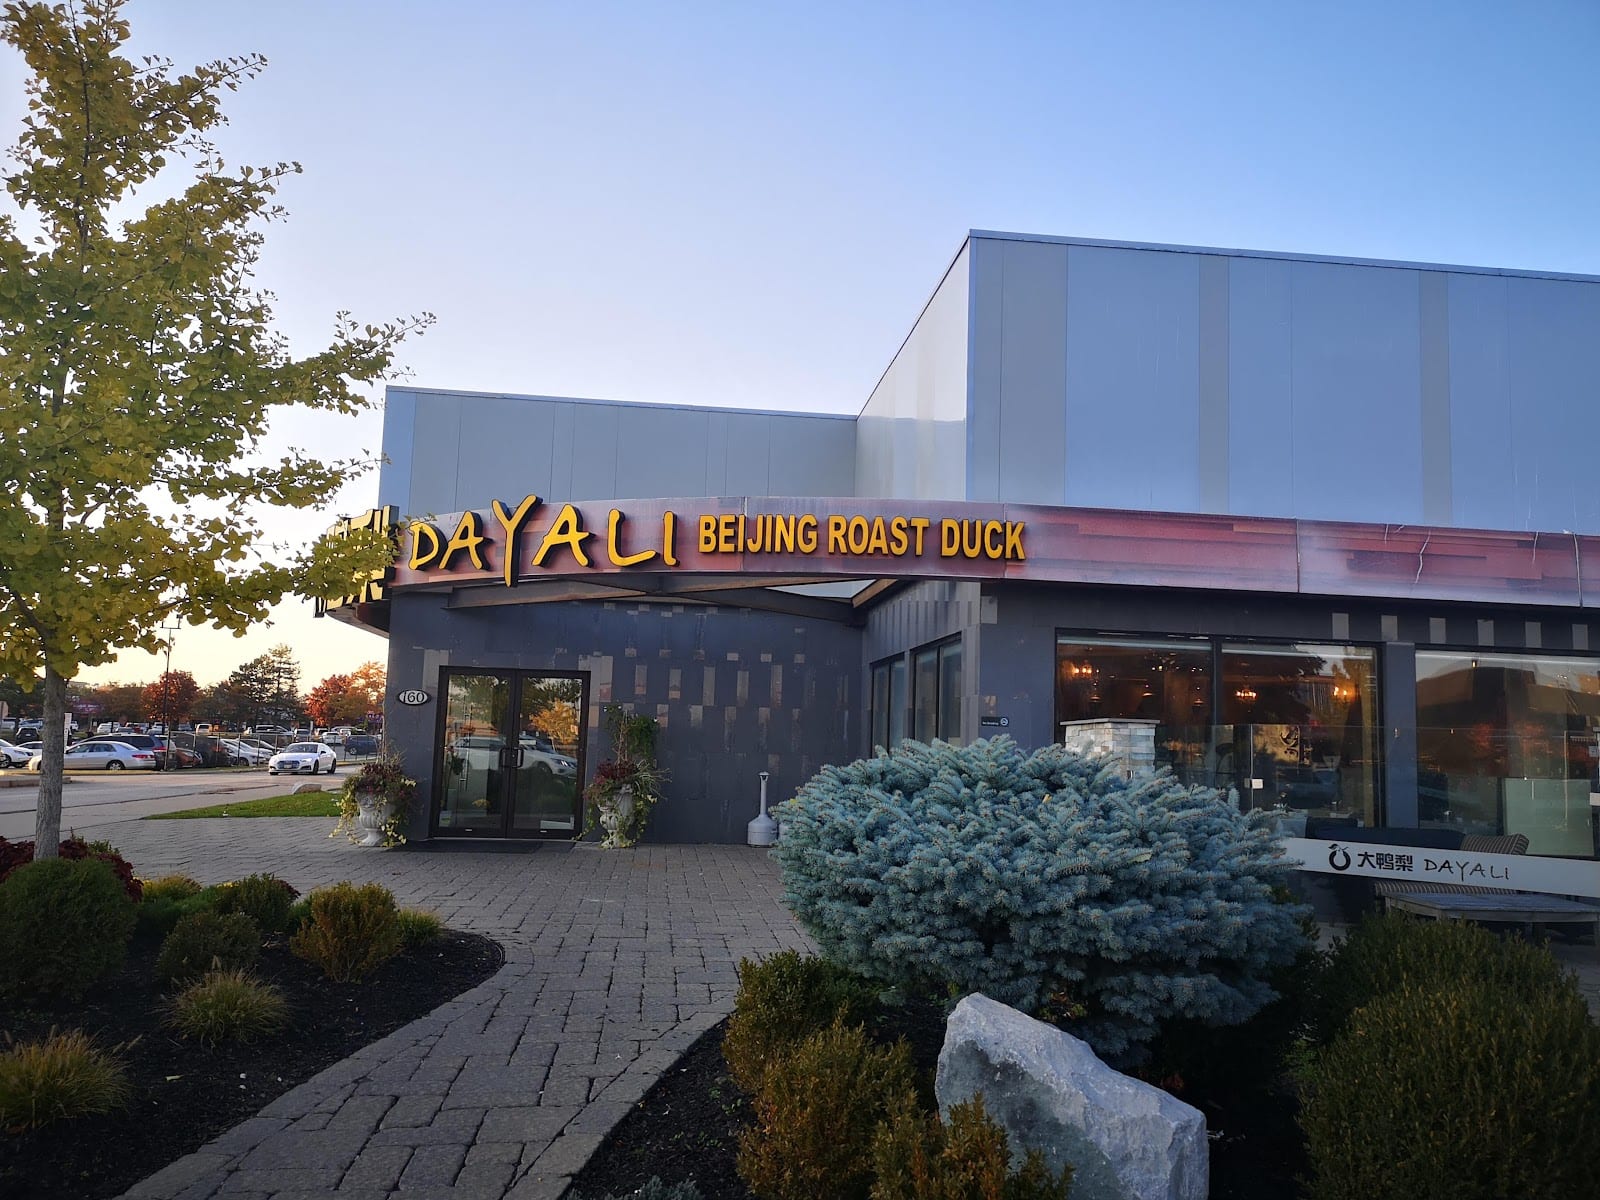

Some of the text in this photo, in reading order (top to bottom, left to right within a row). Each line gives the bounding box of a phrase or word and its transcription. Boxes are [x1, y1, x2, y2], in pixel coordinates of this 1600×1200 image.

[408, 494, 1026, 587] DAYALI BEIJING ROAST DUCK
[404, 691, 425, 703] 160
[1357, 852, 1509, 881] 大鸭梨 DAYALI
